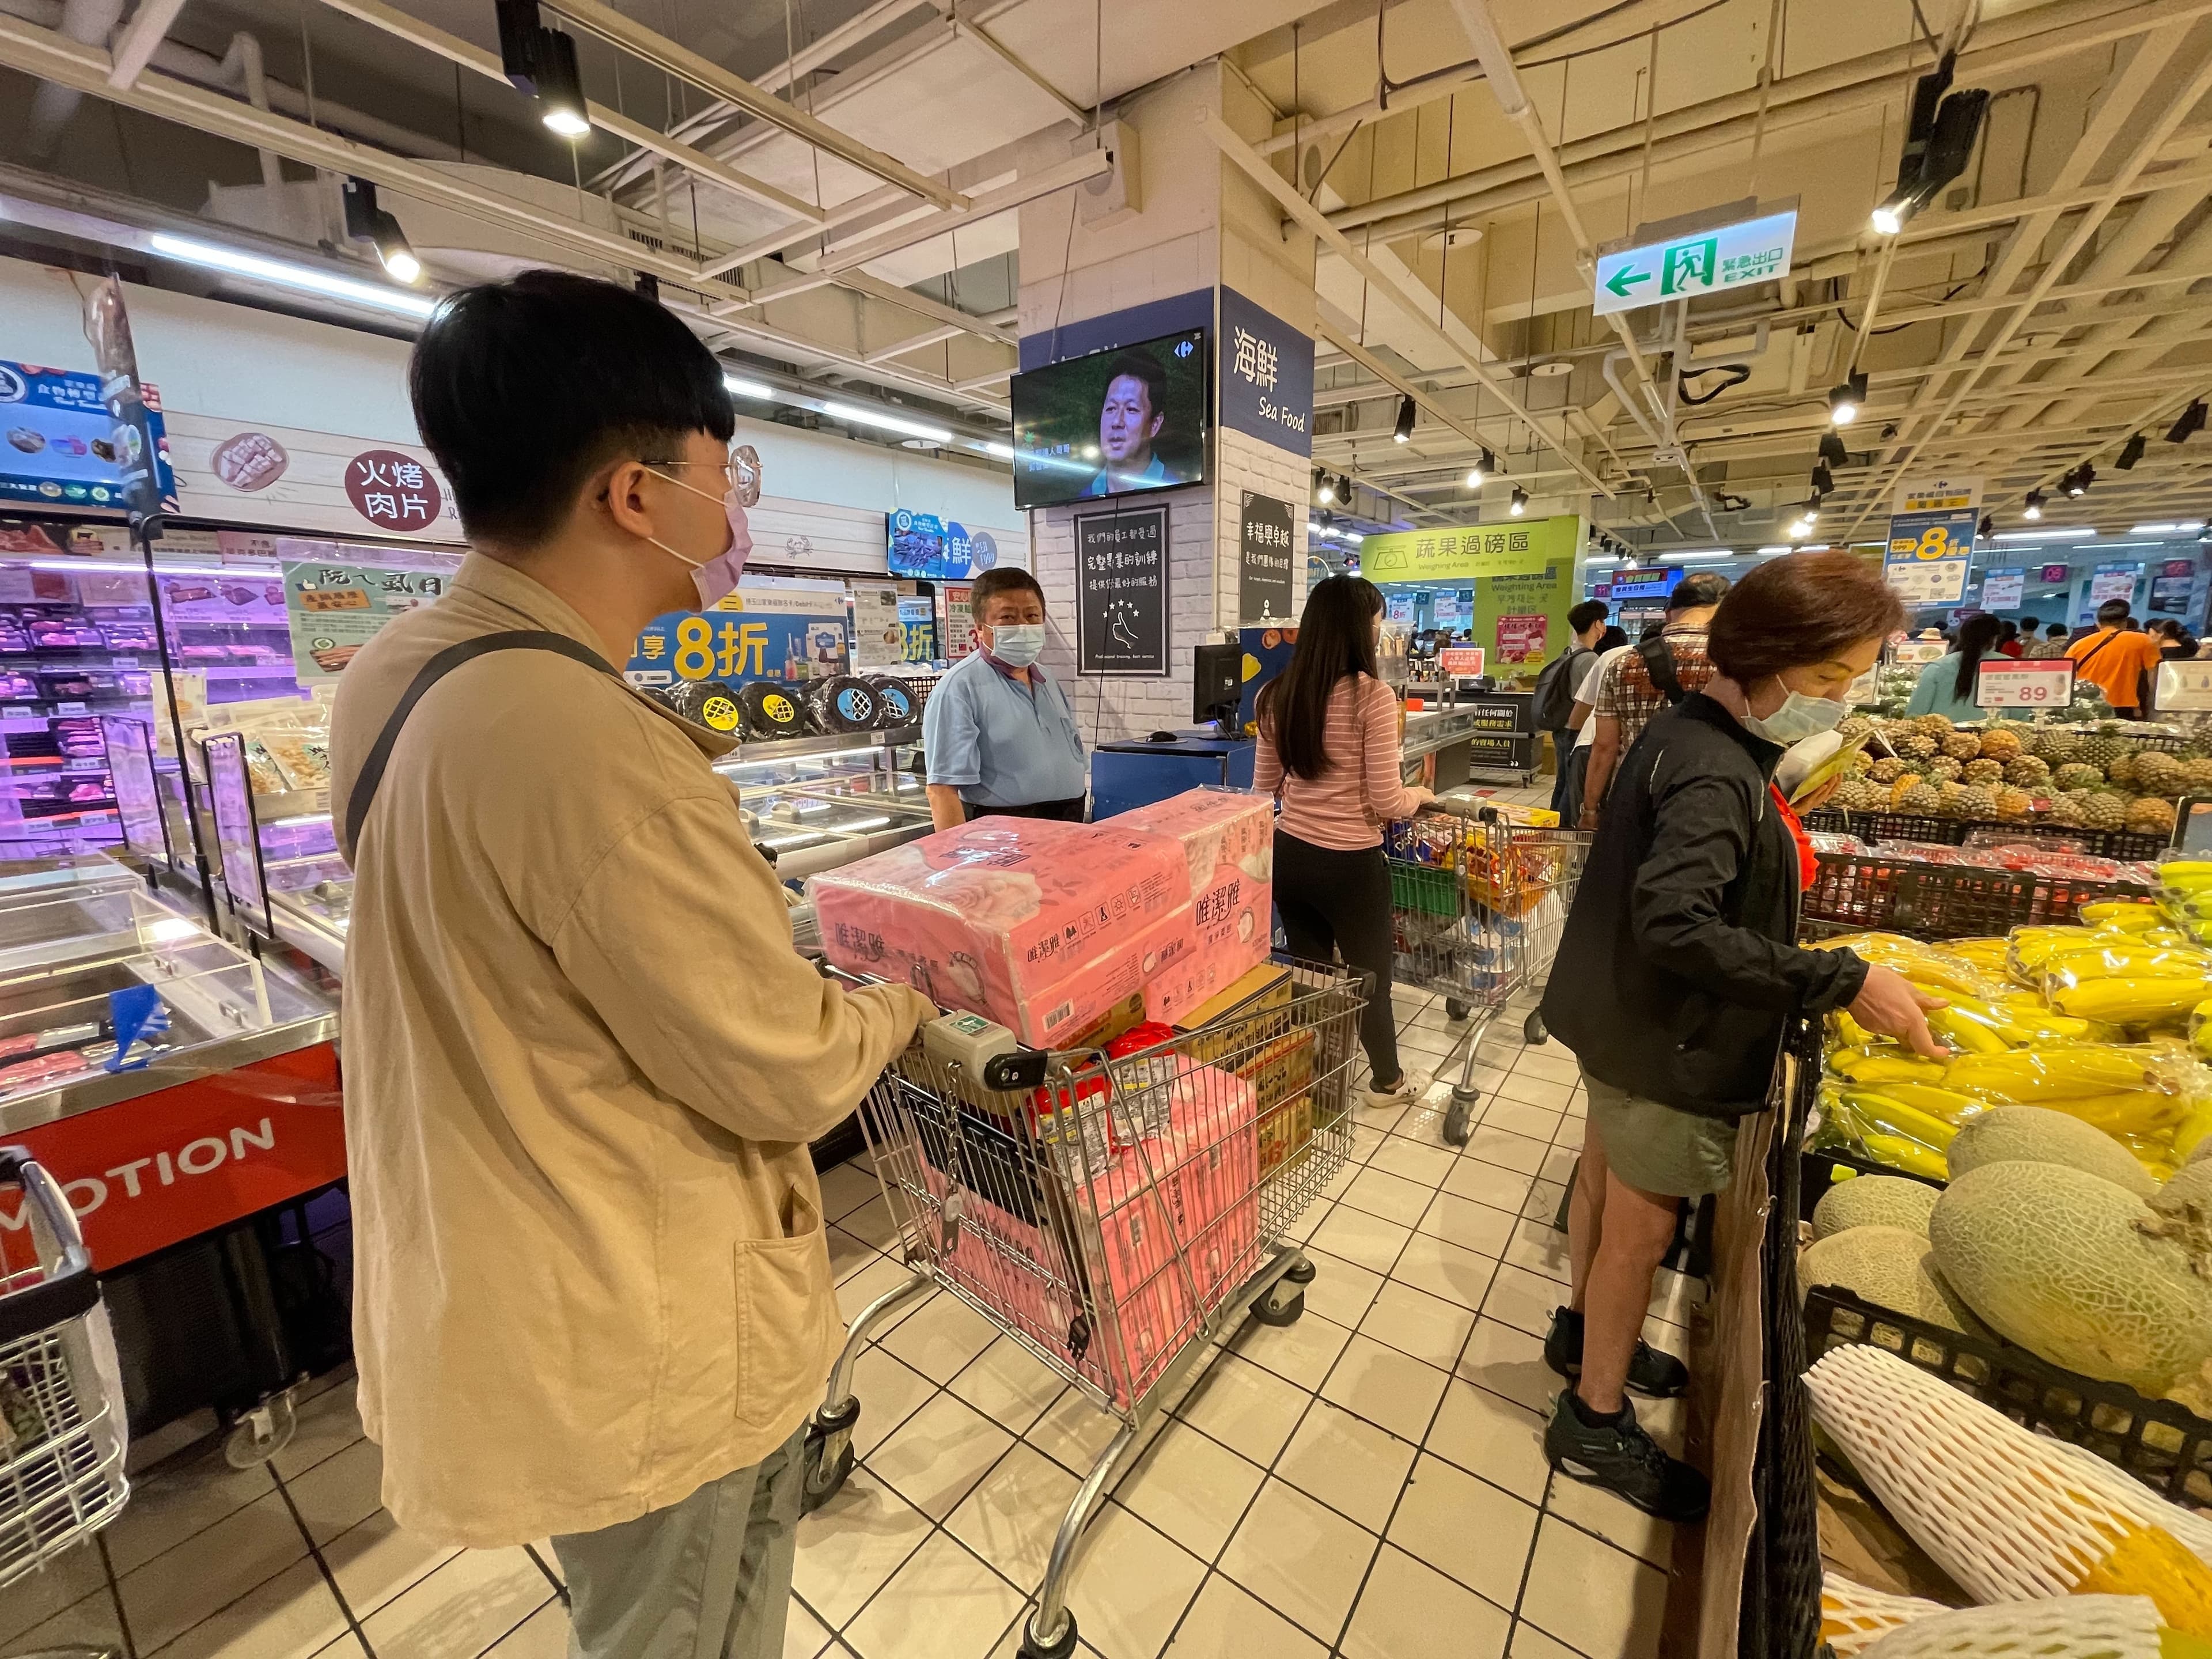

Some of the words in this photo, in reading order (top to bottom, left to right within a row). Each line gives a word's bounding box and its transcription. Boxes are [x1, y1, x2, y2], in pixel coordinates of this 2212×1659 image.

[1722, 247, 1783, 272] 緊急出口
[1724, 263, 1779, 282] EXIT
[1234, 325, 1278, 392] 海鮮
[1259, 397, 1278, 422] Sea
[1281, 406, 1305, 433] Food
[357, 460, 423, 488] 火烤
[365, 492, 428, 519] 肉片
[1416, 531, 1530, 558] 蔬果過磅區
[674, 617, 768, 680] 8折
[2018, 687, 2048, 702] 89
